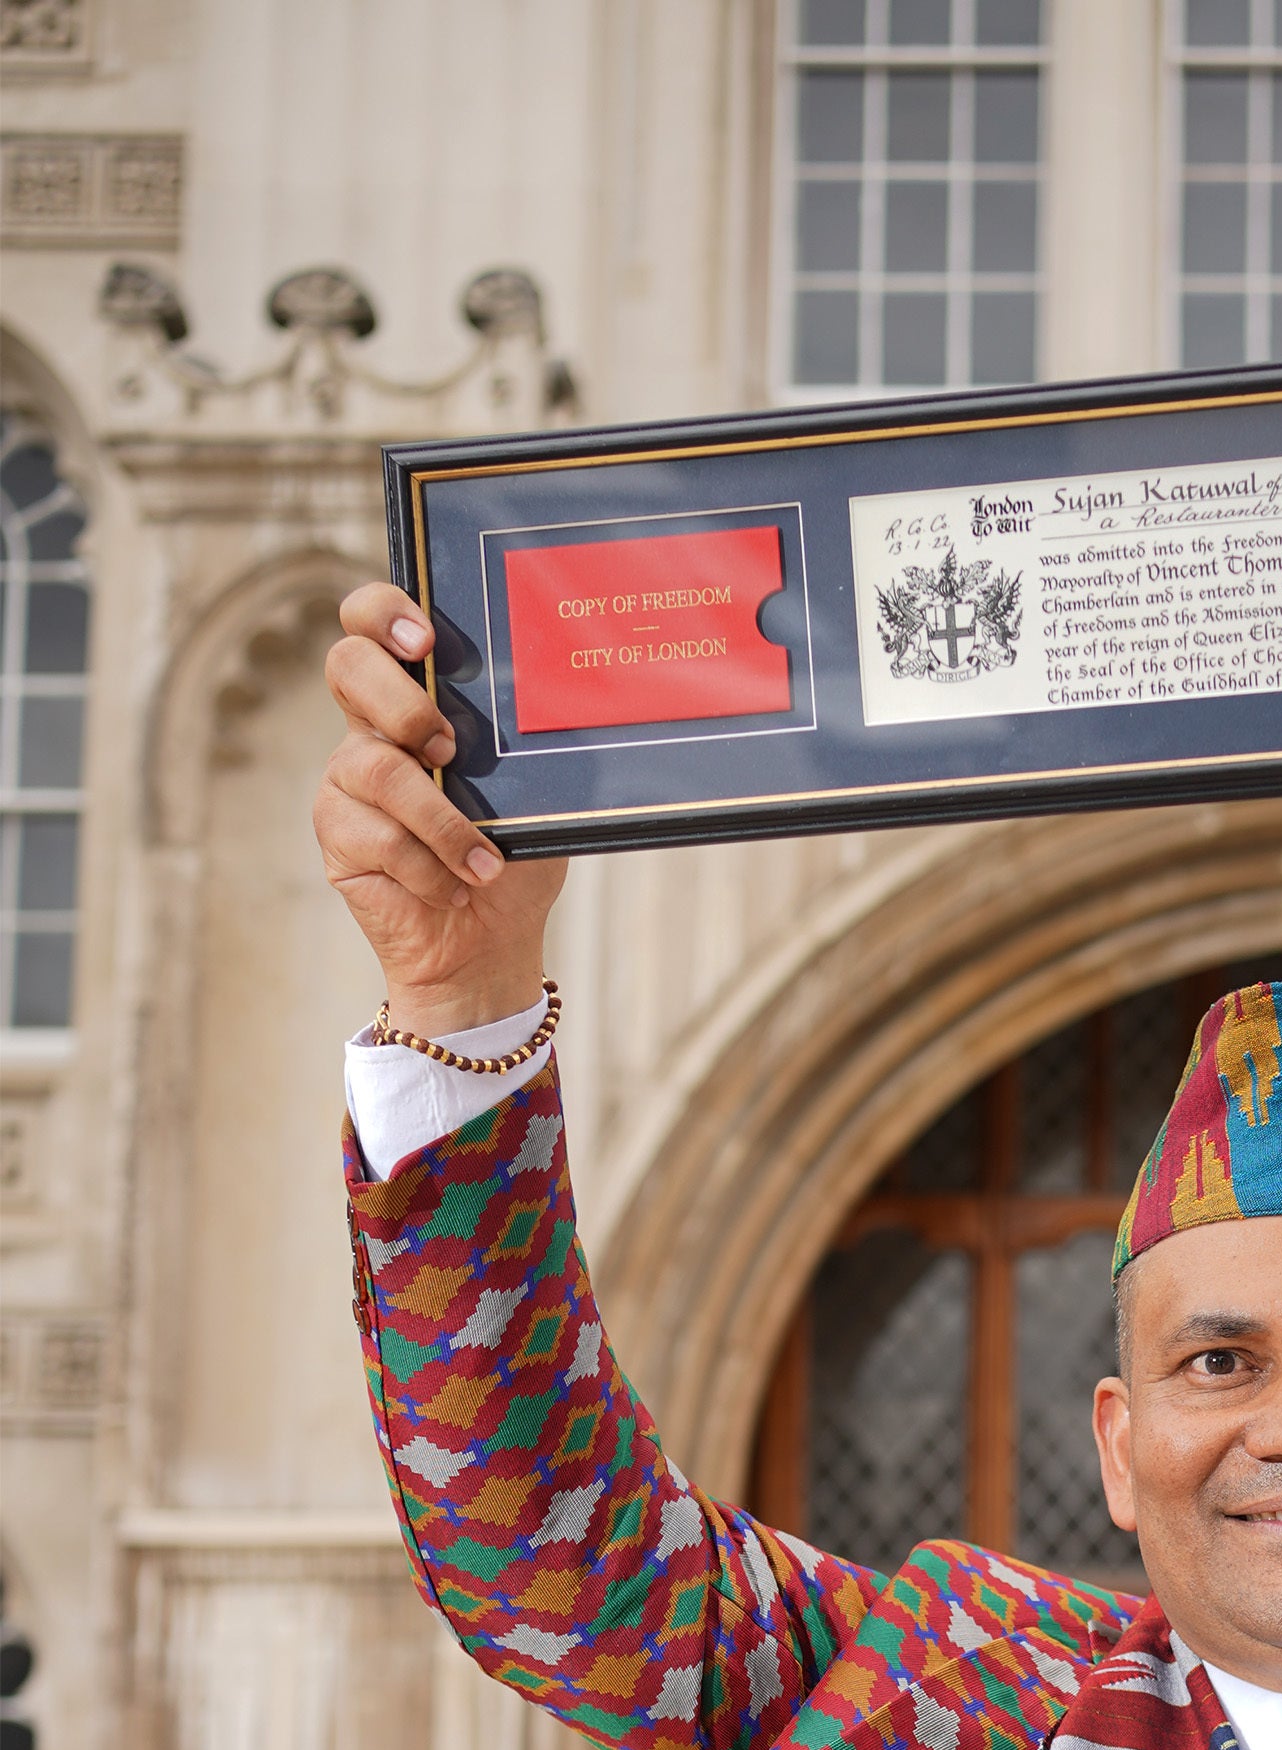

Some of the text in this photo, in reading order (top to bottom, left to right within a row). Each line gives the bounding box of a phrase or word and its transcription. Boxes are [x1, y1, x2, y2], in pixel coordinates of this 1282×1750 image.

[968, 493, 1034, 521] London
[1050, 484, 1125, 522] Sujan
[1139, 471, 1262, 505] Katuwal
[969, 516, 1037, 545] To Wit
[1099, 516, 1120, 530] a
[1038, 553, 1071, 567] was
[1077, 541, 1146, 564] admitted
[1152, 540, 1184, 557] into
[1190, 535, 1215, 556] the
[1039, 568, 1124, 594] Mayoralty
[1126, 565, 1142, 587] of
[1145, 557, 1220, 583] Vincent
[558, 586, 732, 619] COPY OF FREEDOM
[1041, 590, 1140, 616] Chamberlain
[1145, 585, 1175, 606] and
[1179, 585, 1194, 603] is
[1198, 578, 1256, 601] entered
[1260, 578, 1277, 595] in
[1043, 618, 1059, 640] of
[1062, 614, 1137, 639] Freedoms
[1140, 608, 1170, 629] and
[1173, 607, 1198, 628] the
[570, 637, 727, 669] CITY OF LONDON
[1044, 645, 1079, 664] year
[1083, 637, 1098, 659] of
[1102, 636, 1126, 657] the
[1129, 634, 1171, 655] reign
[1173, 630, 1189, 652] of
[1192, 630, 1244, 648] Queen
[1046, 663, 1072, 684] the
[1077, 659, 1116, 680] Seal
[1119, 657, 1136, 679] of
[1140, 655, 1167, 677] the
[1172, 651, 1225, 674] Office
[1231, 648, 1248, 670] of
[1047, 682, 1122, 706] Chamber
[1127, 679, 1144, 700] of
[1149, 677, 1175, 698] the
[1181, 669, 1262, 694] Guildhall
[1265, 667, 1282, 688] of
